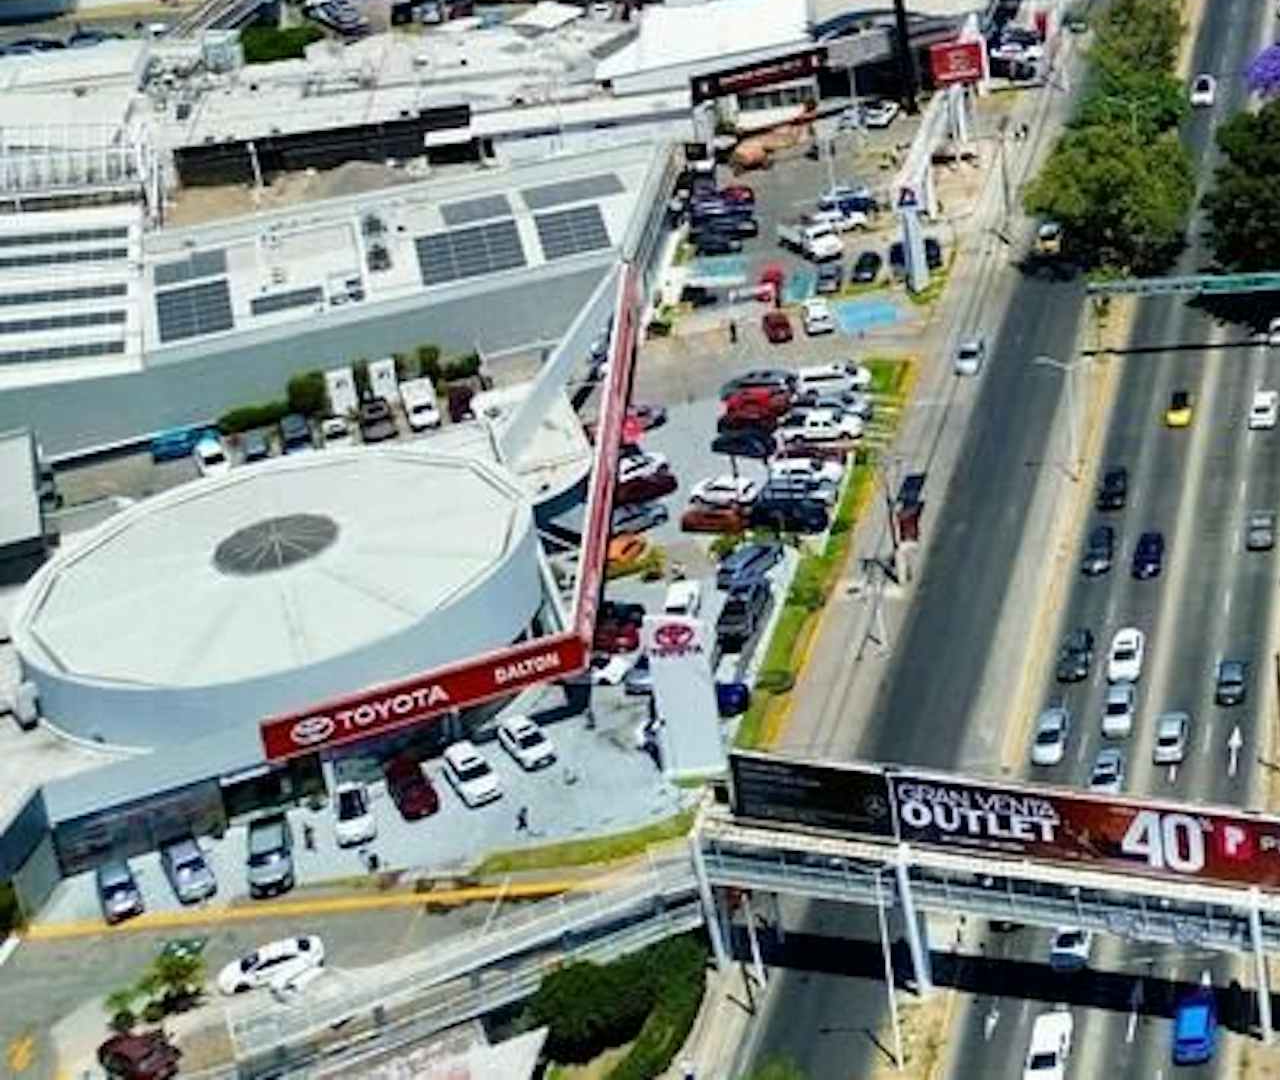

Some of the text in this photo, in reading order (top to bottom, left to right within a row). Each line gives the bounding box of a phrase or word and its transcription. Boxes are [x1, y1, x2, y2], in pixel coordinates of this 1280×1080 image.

[494, 651, 561, 684] DALTON
[340, 684, 449, 731] TOYOTA
[898, 783, 1057, 819] GRAN VENTA
[901, 801, 1060, 842] OUTLET
